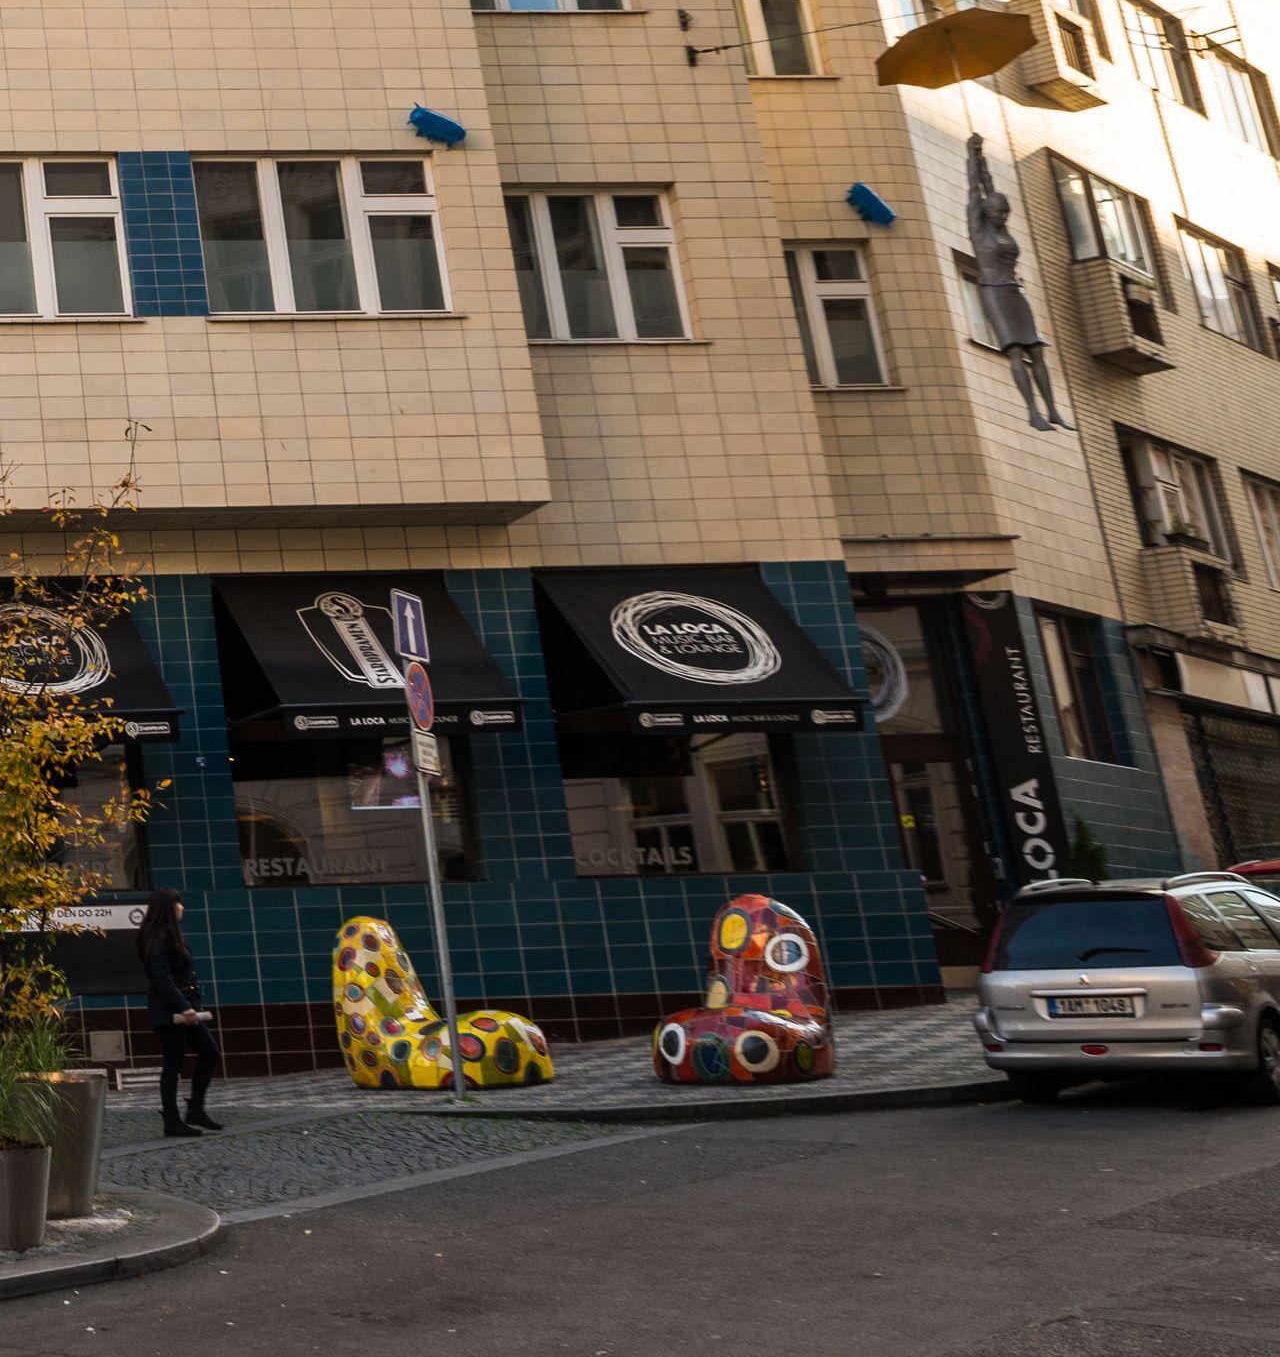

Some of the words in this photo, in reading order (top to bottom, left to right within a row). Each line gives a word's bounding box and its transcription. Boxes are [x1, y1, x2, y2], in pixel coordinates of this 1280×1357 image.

[642, 624, 671, 635] LA
[671, 623, 730, 635] LOCA
[650, 635, 703, 644] MUSIC
[708, 635, 738, 644] BAR
[676, 644, 744, 654] LOUNGE
[1005, 646, 1043, 754] RESTAURANT
[363, 717, 386, 726] LOCA
[575, 846, 694, 867] COCKTAILS
[242, 855, 387, 879] RESTAURANT
[57, 909, 76, 918] DEN
[78, 909, 92, 917] DO
[95, 908, 112, 917] 22H
